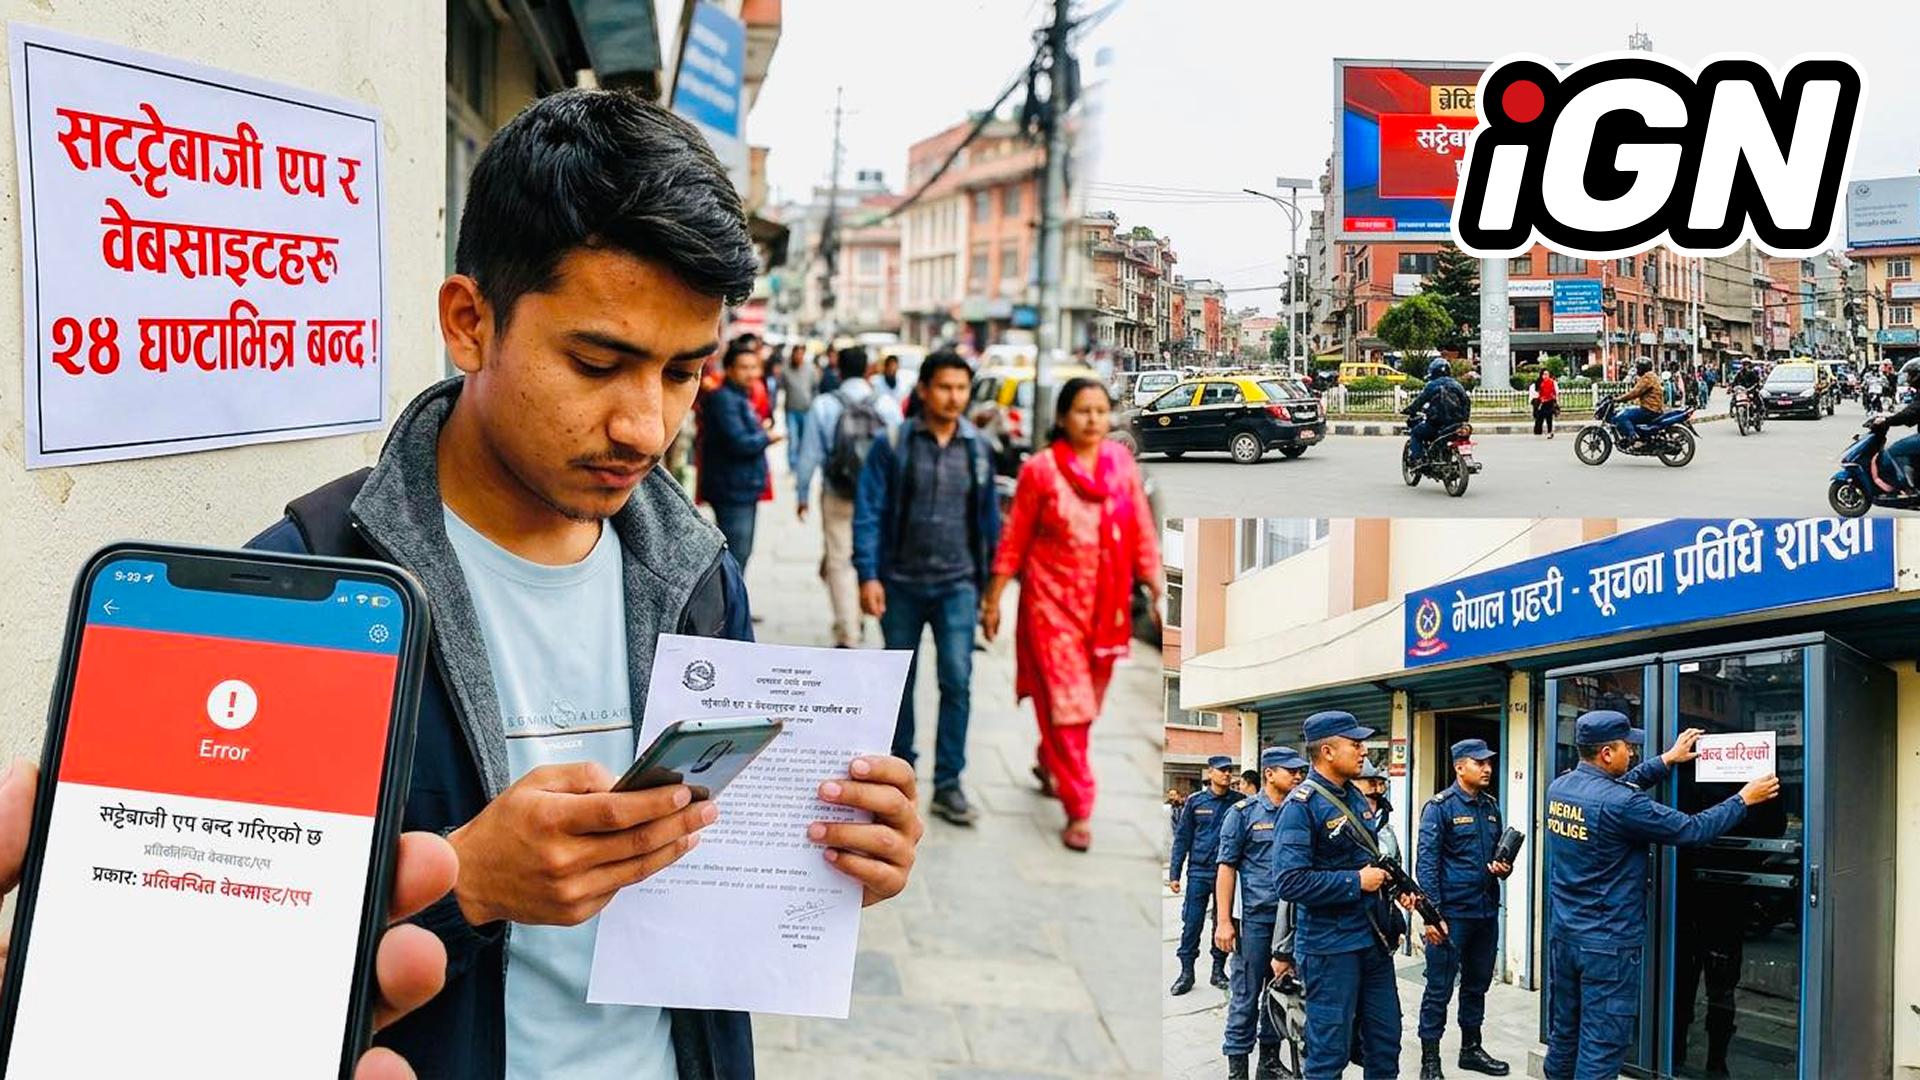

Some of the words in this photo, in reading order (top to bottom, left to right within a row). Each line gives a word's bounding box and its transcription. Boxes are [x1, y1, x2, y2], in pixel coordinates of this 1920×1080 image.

[1415, 124, 1473, 154] सट्टेबा
[277, 145, 326, 198] एप
[338, 157, 360, 204] र
[101, 198, 338, 286] वेबसाइटहरू
[52, 316, 120, 375] २४
[138, 299, 296, 373] घण्टाभित्र
[1452, 590, 1505, 632] नेपाल
[1511, 566, 1564, 628] प्रहरी
[1589, 553, 1665, 617] सूचना
[1674, 518, 1764, 595] प्रविधि
[1775, 518, 1873, 571] शाखा
[199, 739, 250, 761] Error
[100, 803, 167, 829] सट्टेबाजी
[172, 815, 197, 833] एप
[201, 817, 233, 838] बन्द
[237, 818, 302, 844] गरिएको
[307, 828, 323, 846] छ
[92, 866, 137, 886] प्रकार:
